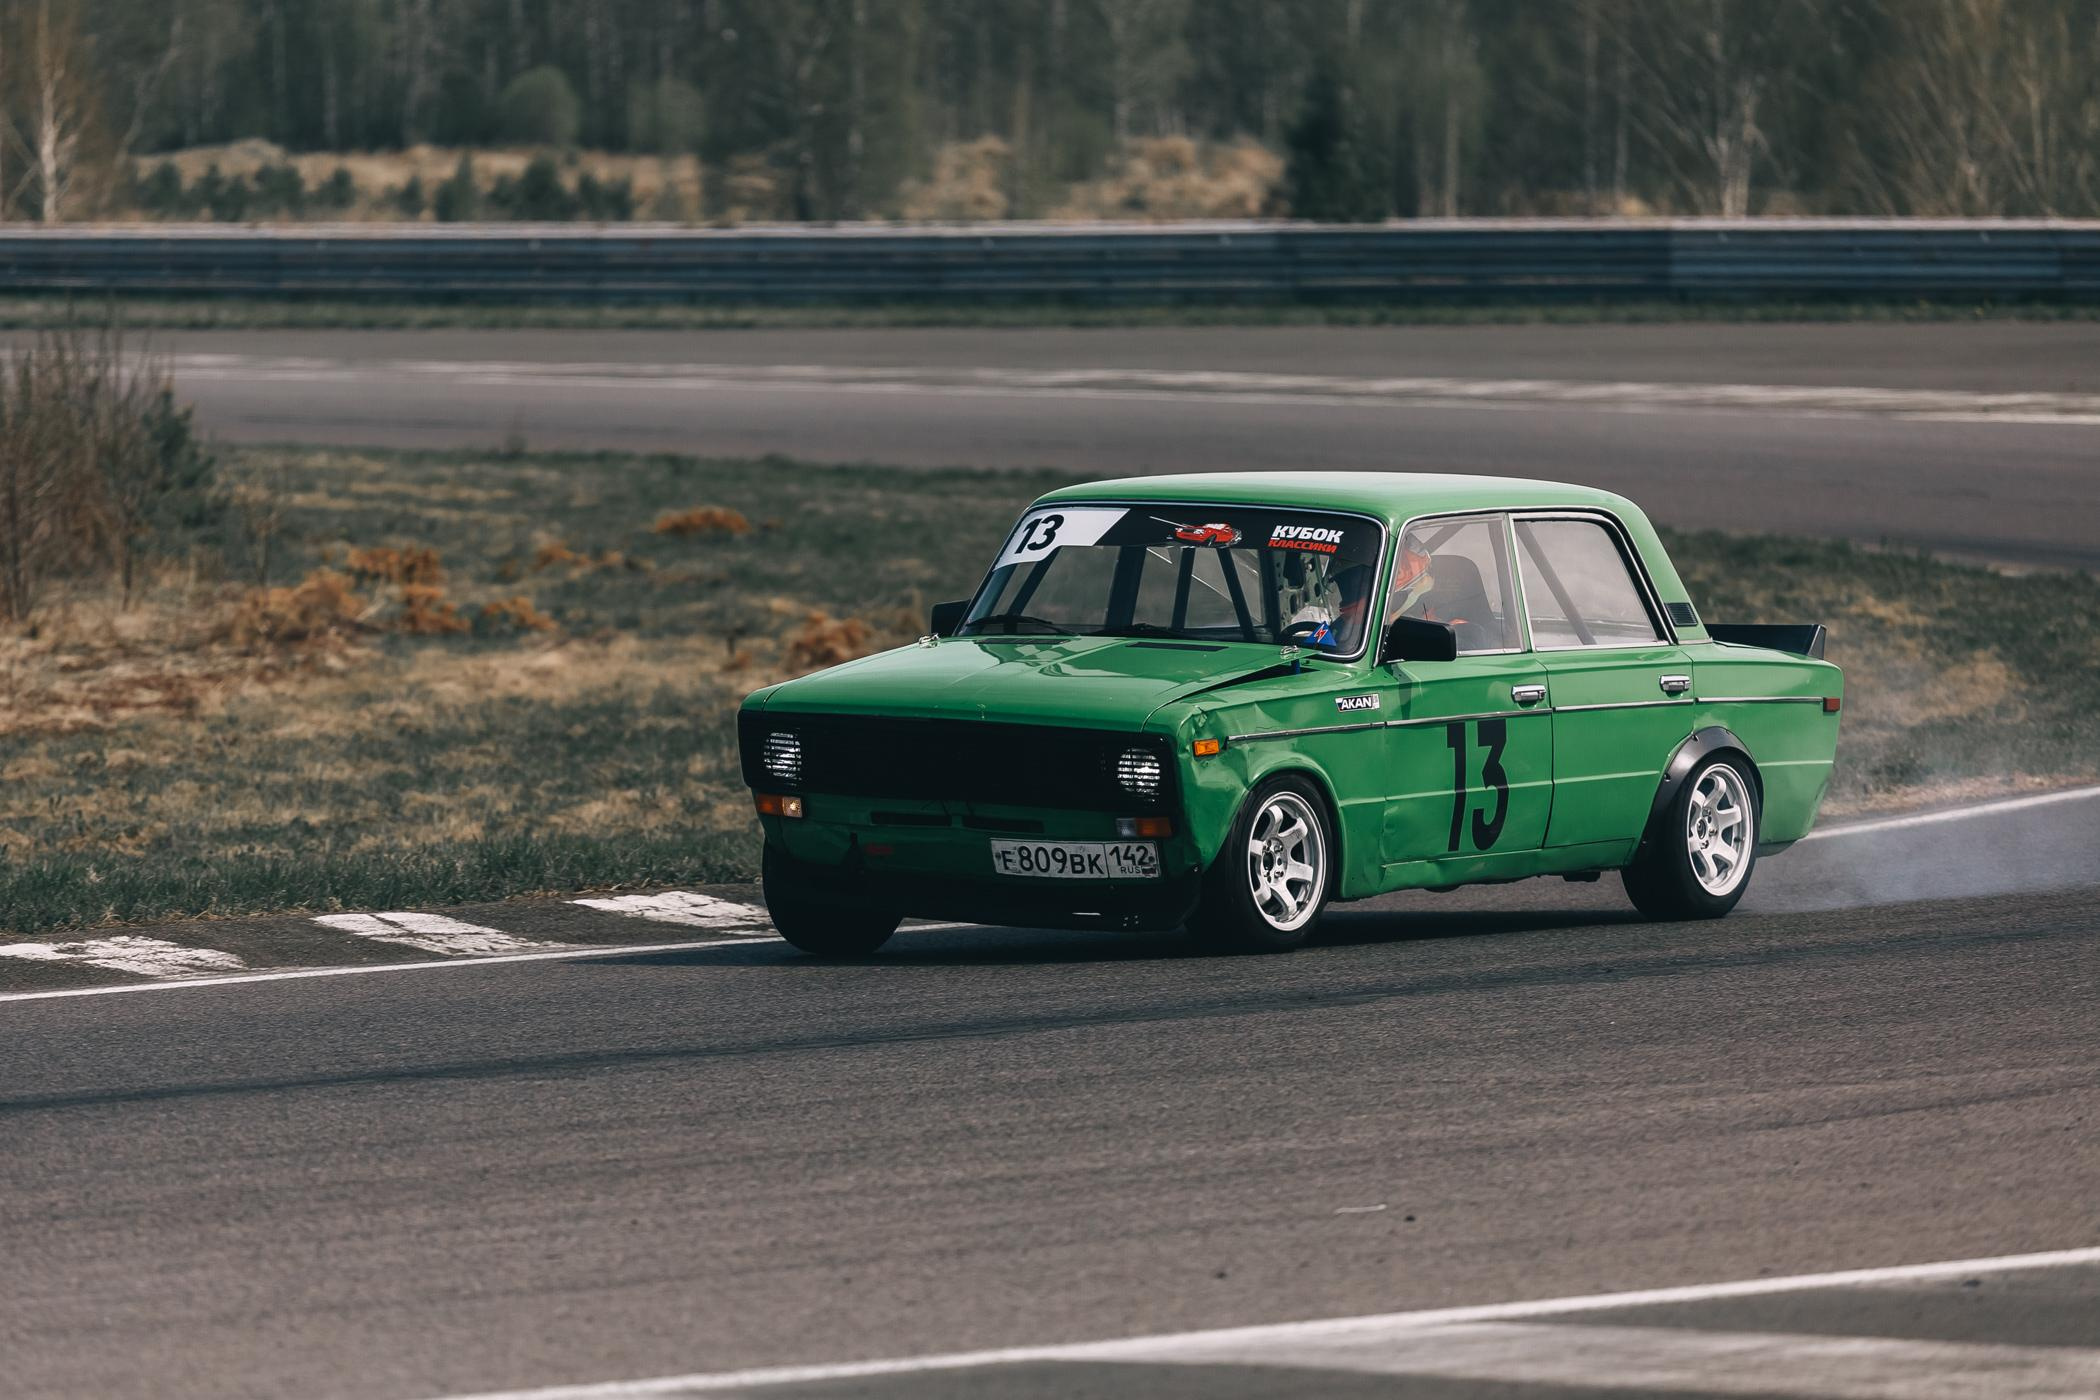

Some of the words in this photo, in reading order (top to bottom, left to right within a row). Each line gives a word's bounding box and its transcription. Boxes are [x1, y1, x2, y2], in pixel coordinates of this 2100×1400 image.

[1014, 514, 1064, 554] 13
[1272, 525, 1344, 543] КУБОК
[1267, 539, 1337, 553] КЛАССИКИ
[1341, 696, 1372, 709] AKAN
[1447, 718, 1509, 852] 13
[1109, 845, 1148, 866] 142
[1121, 866, 1141, 874] RUS
